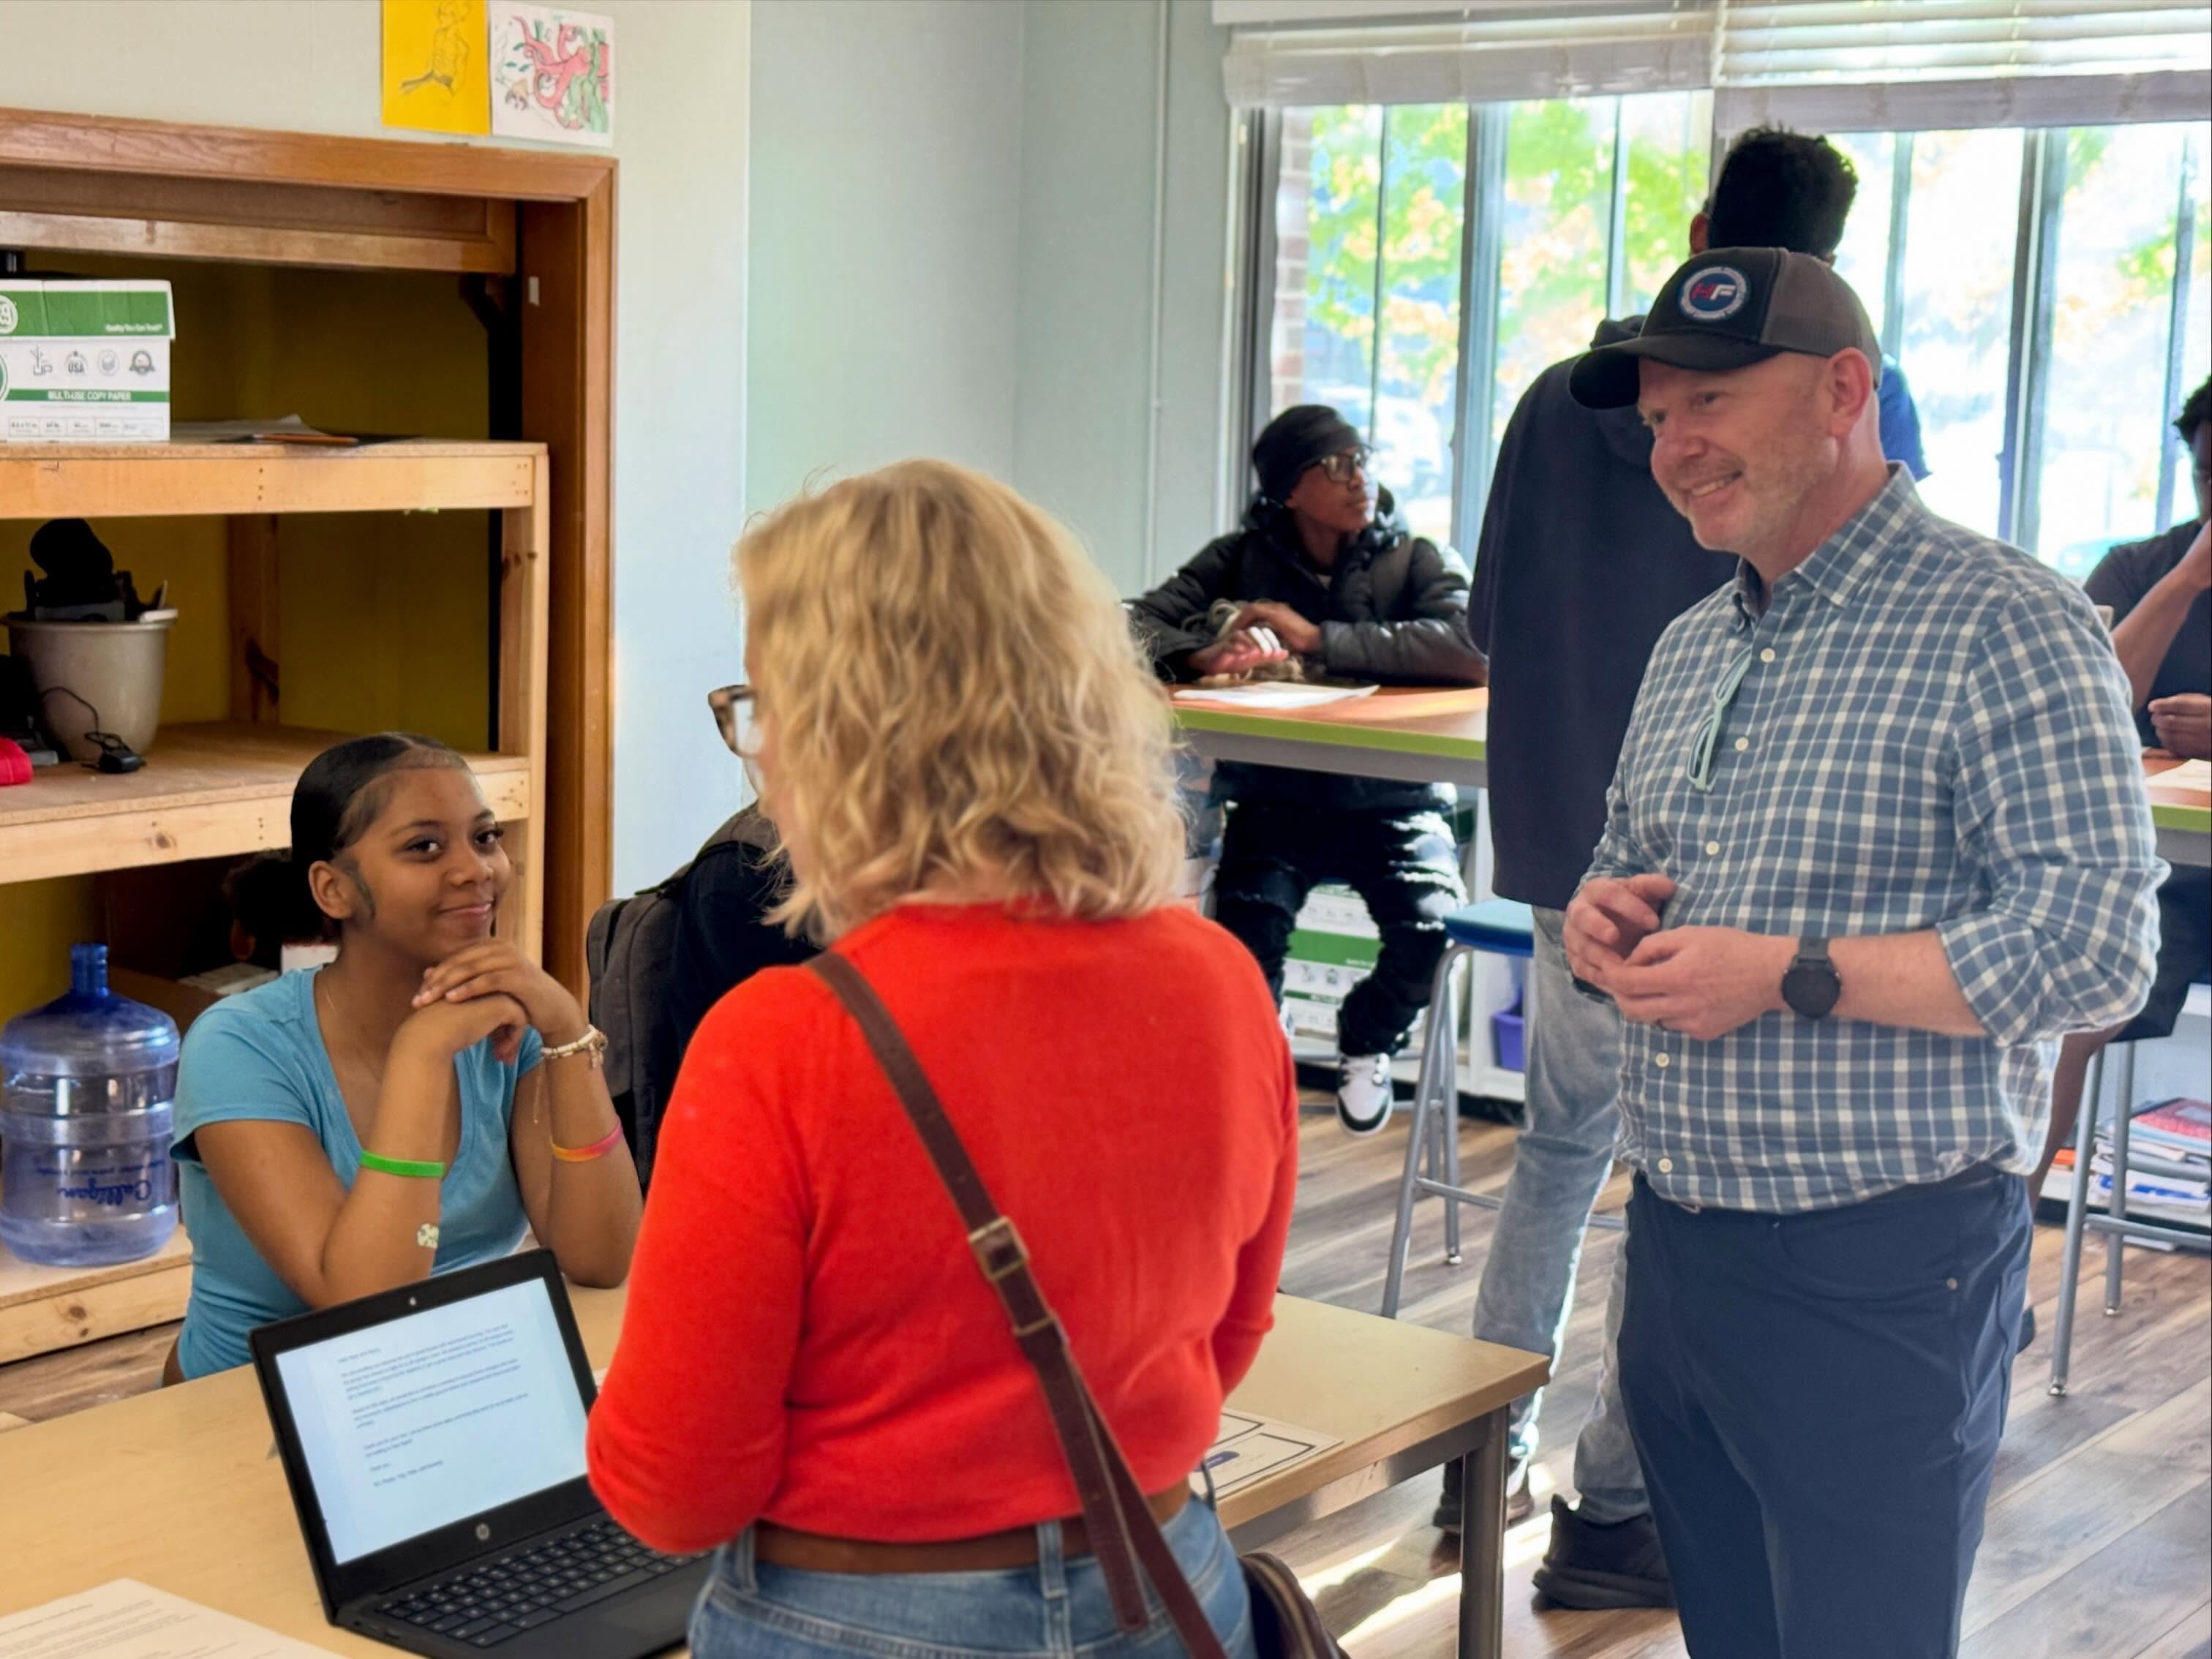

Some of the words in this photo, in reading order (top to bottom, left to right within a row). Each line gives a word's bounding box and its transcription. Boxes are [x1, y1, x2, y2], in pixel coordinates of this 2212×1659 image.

[68, 362, 85, 373] USA
[88, 391, 107, 401] COPY
[108, 391, 131, 401] PAPER
[58, 1178, 151, 1205] Culligan
